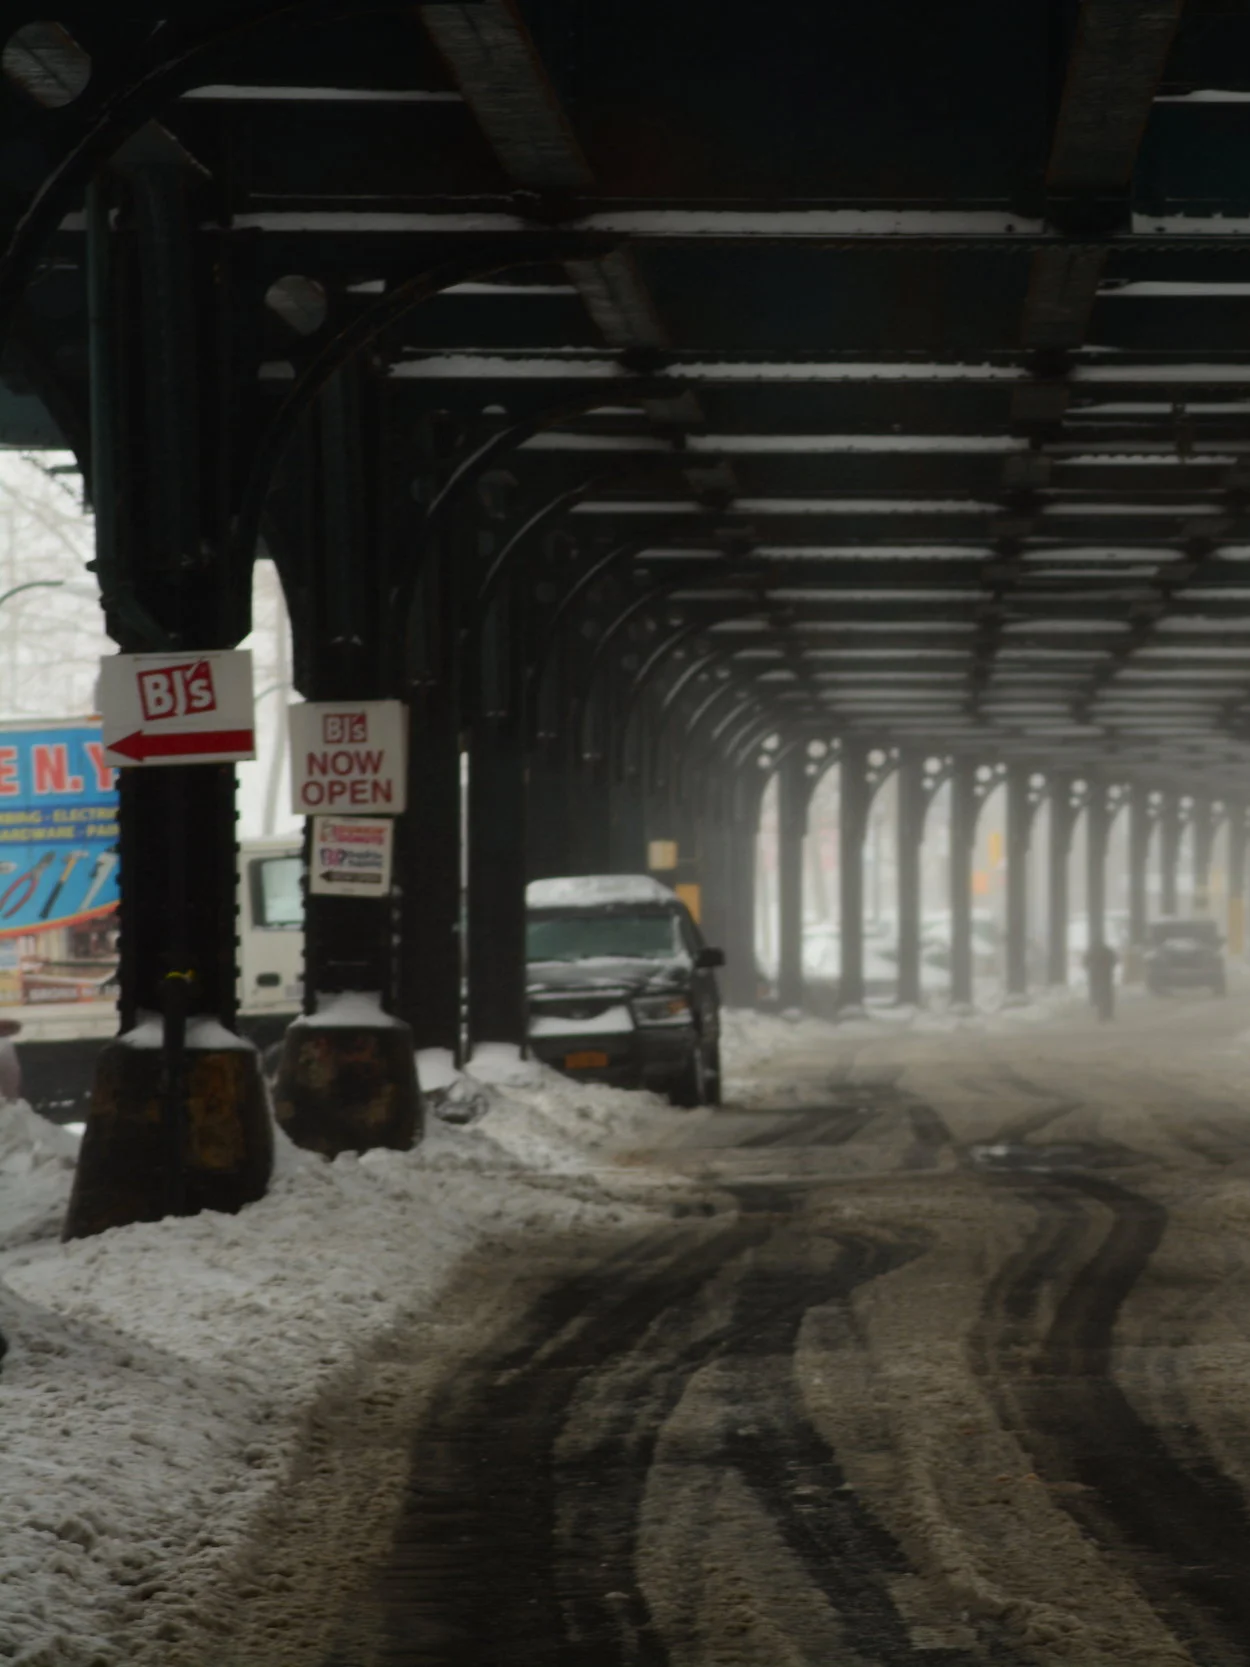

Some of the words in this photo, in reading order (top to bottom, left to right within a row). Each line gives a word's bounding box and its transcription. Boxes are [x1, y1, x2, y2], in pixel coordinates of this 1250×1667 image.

[142, 661, 213, 718] BJ's
[325, 713, 368, 744] BJ's
[31, 742, 118, 794] N.Y
[307, 750, 385, 777] NOW
[302, 779, 393, 807] OPEN
